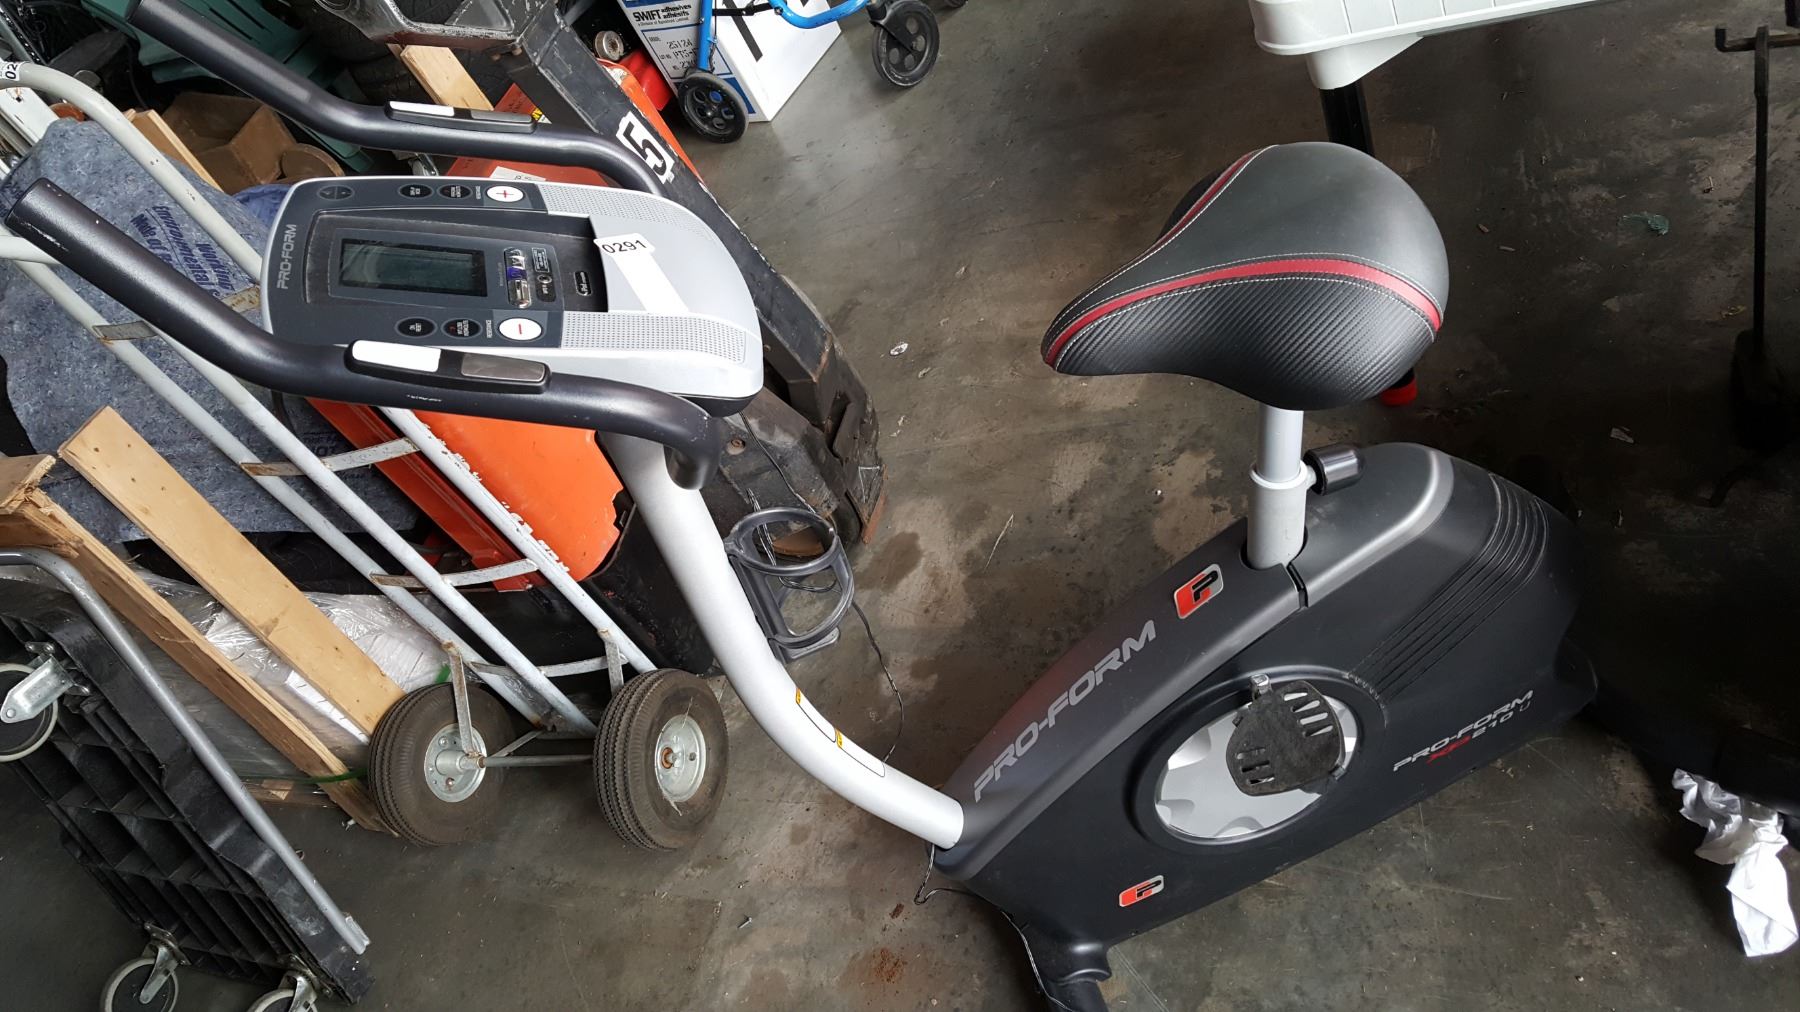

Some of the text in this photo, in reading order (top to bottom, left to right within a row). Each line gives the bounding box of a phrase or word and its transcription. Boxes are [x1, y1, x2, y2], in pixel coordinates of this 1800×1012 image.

[632, 10, 661, 22] SWIFT
[660, 4, 692, 13] adhesives
[622, 121, 667, 176] 5
[130, 213, 157, 238] Made
[152, 205, 217, 287] Environmental
[601, 239, 647, 254] 0291
[195, 243, 236, 292] Working
[276, 223, 298, 291] PRO-FORM
[973, 618, 1157, 804] PRO-FORM
[1393, 689, 1534, 772] PRO-FORM
[1472, 711, 1514, 739] 210
